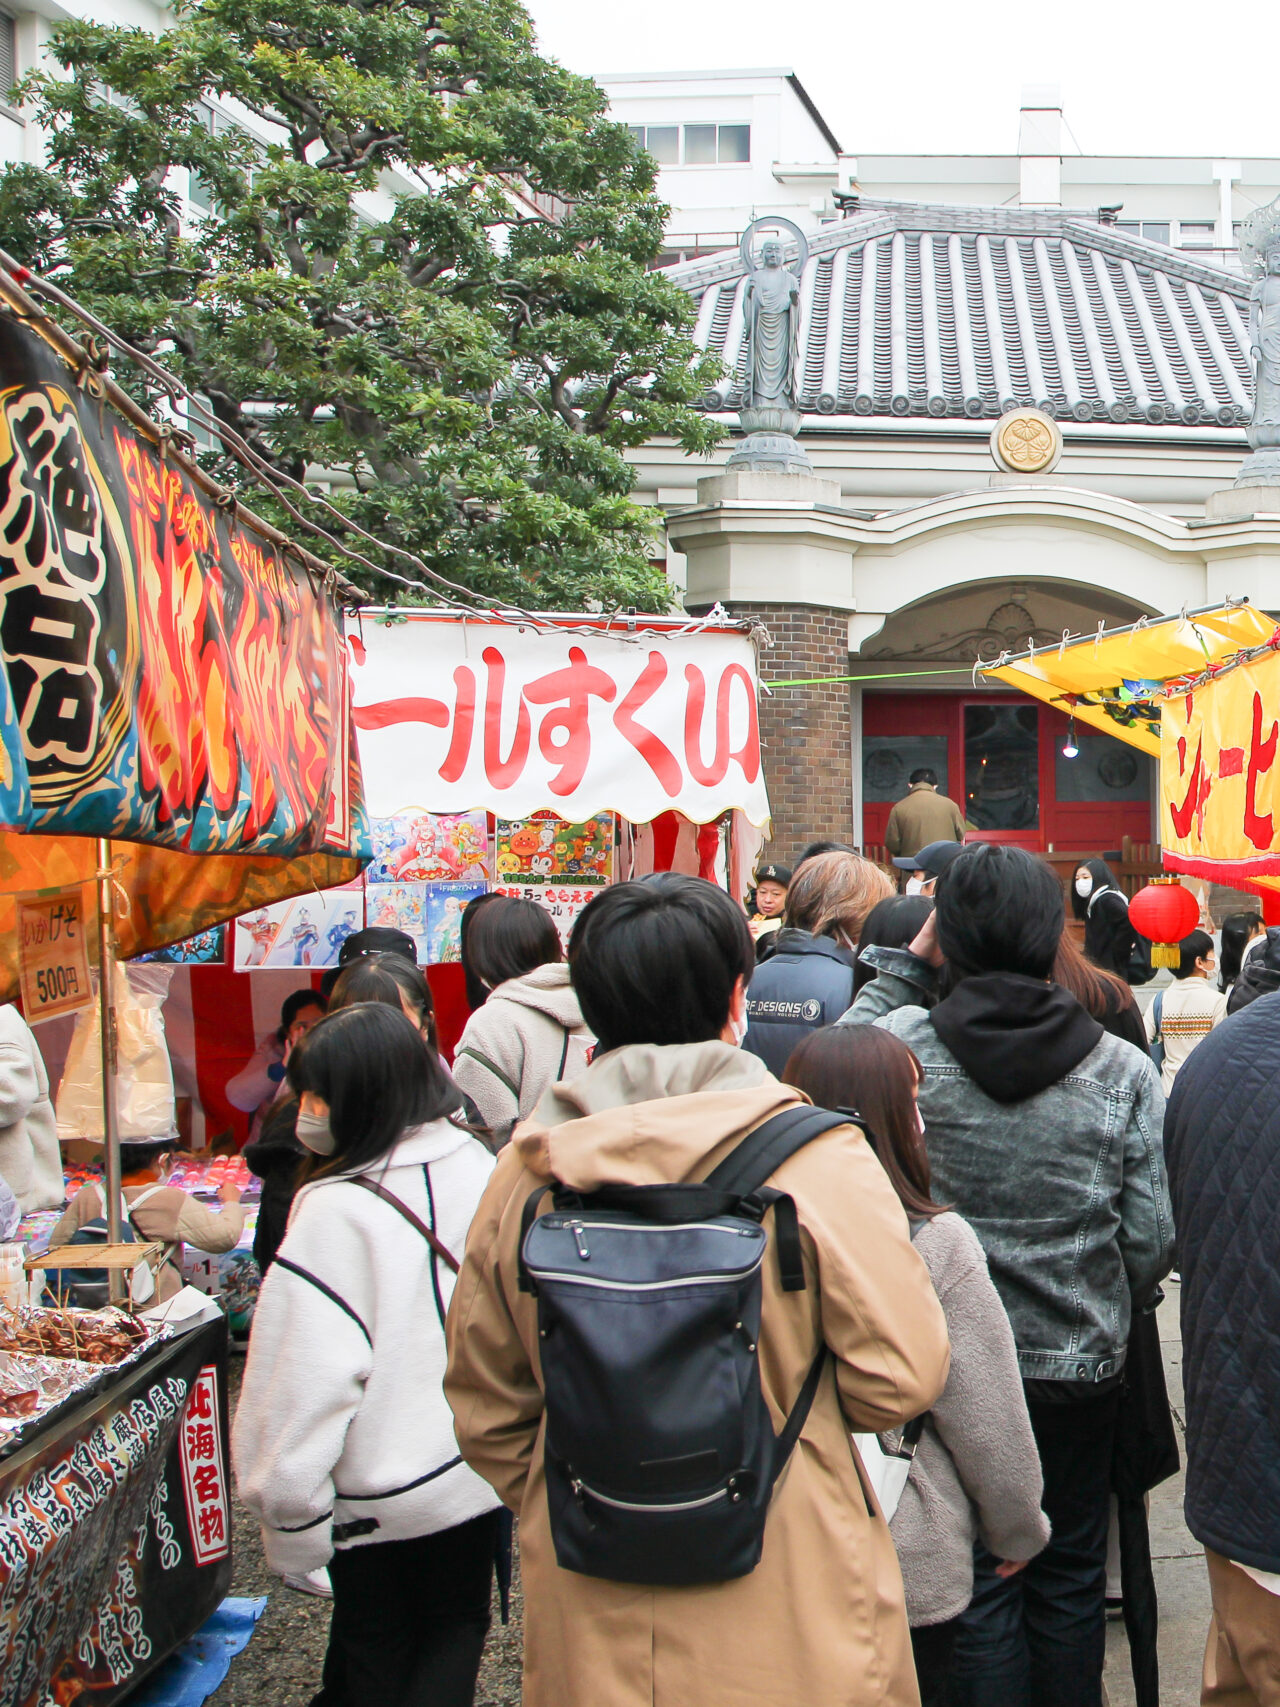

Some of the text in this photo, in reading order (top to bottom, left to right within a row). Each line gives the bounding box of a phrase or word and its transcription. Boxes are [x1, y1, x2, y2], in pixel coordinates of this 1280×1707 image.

[349, 634, 760, 798] ールすくい
[37, 965, 79, 1003] 500円
[758, 1001, 802, 1013] DESIGNS
